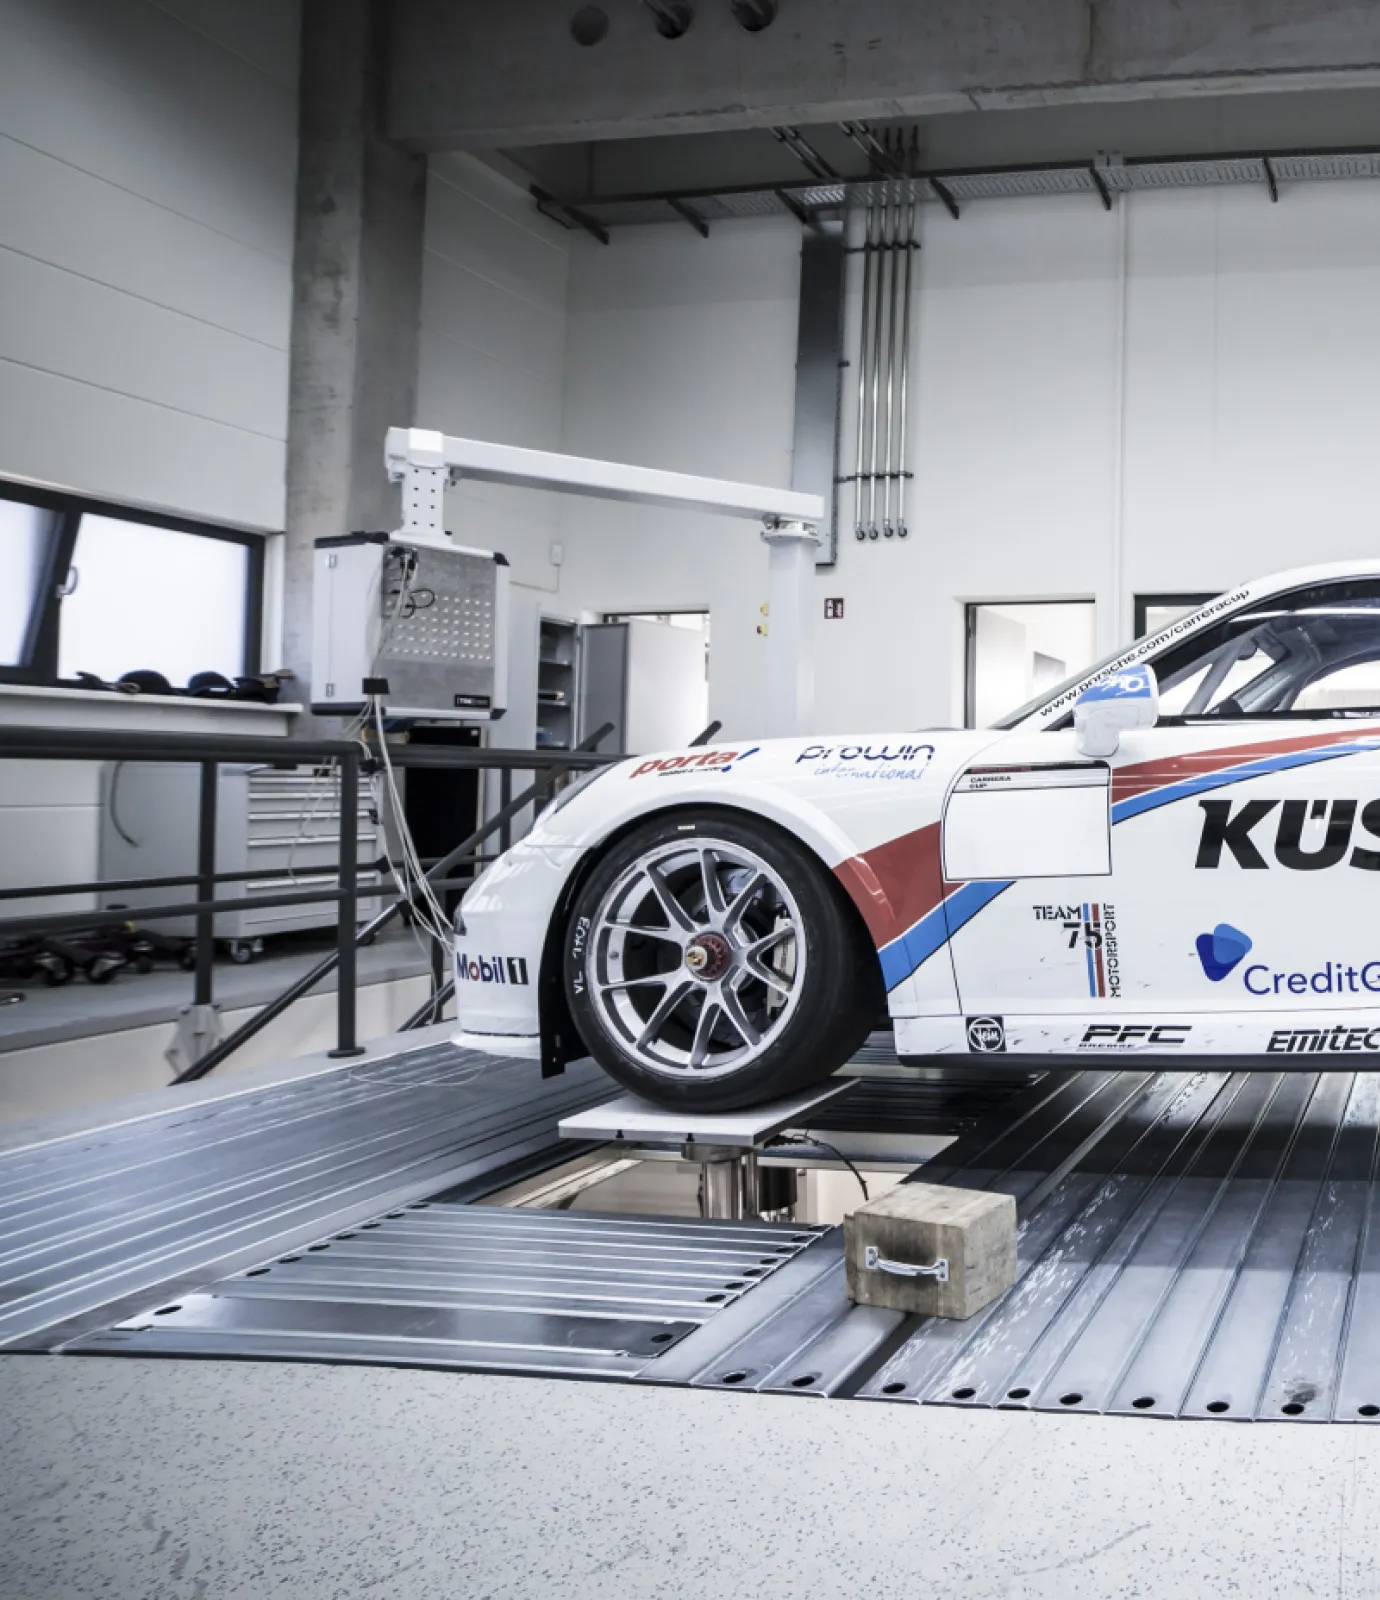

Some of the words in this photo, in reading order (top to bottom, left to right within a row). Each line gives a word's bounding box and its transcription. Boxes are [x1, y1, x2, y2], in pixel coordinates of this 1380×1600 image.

[970, 775, 1012, 783] CARRERA
[1032, 904, 1082, 920] TEAM
[1062, 921, 1103, 949] 75
[1103, 902, 1122, 998] MOTORSPORT
[456, 952, 506, 984] Mobil
[1081, 1024, 1193, 1044] PFC
